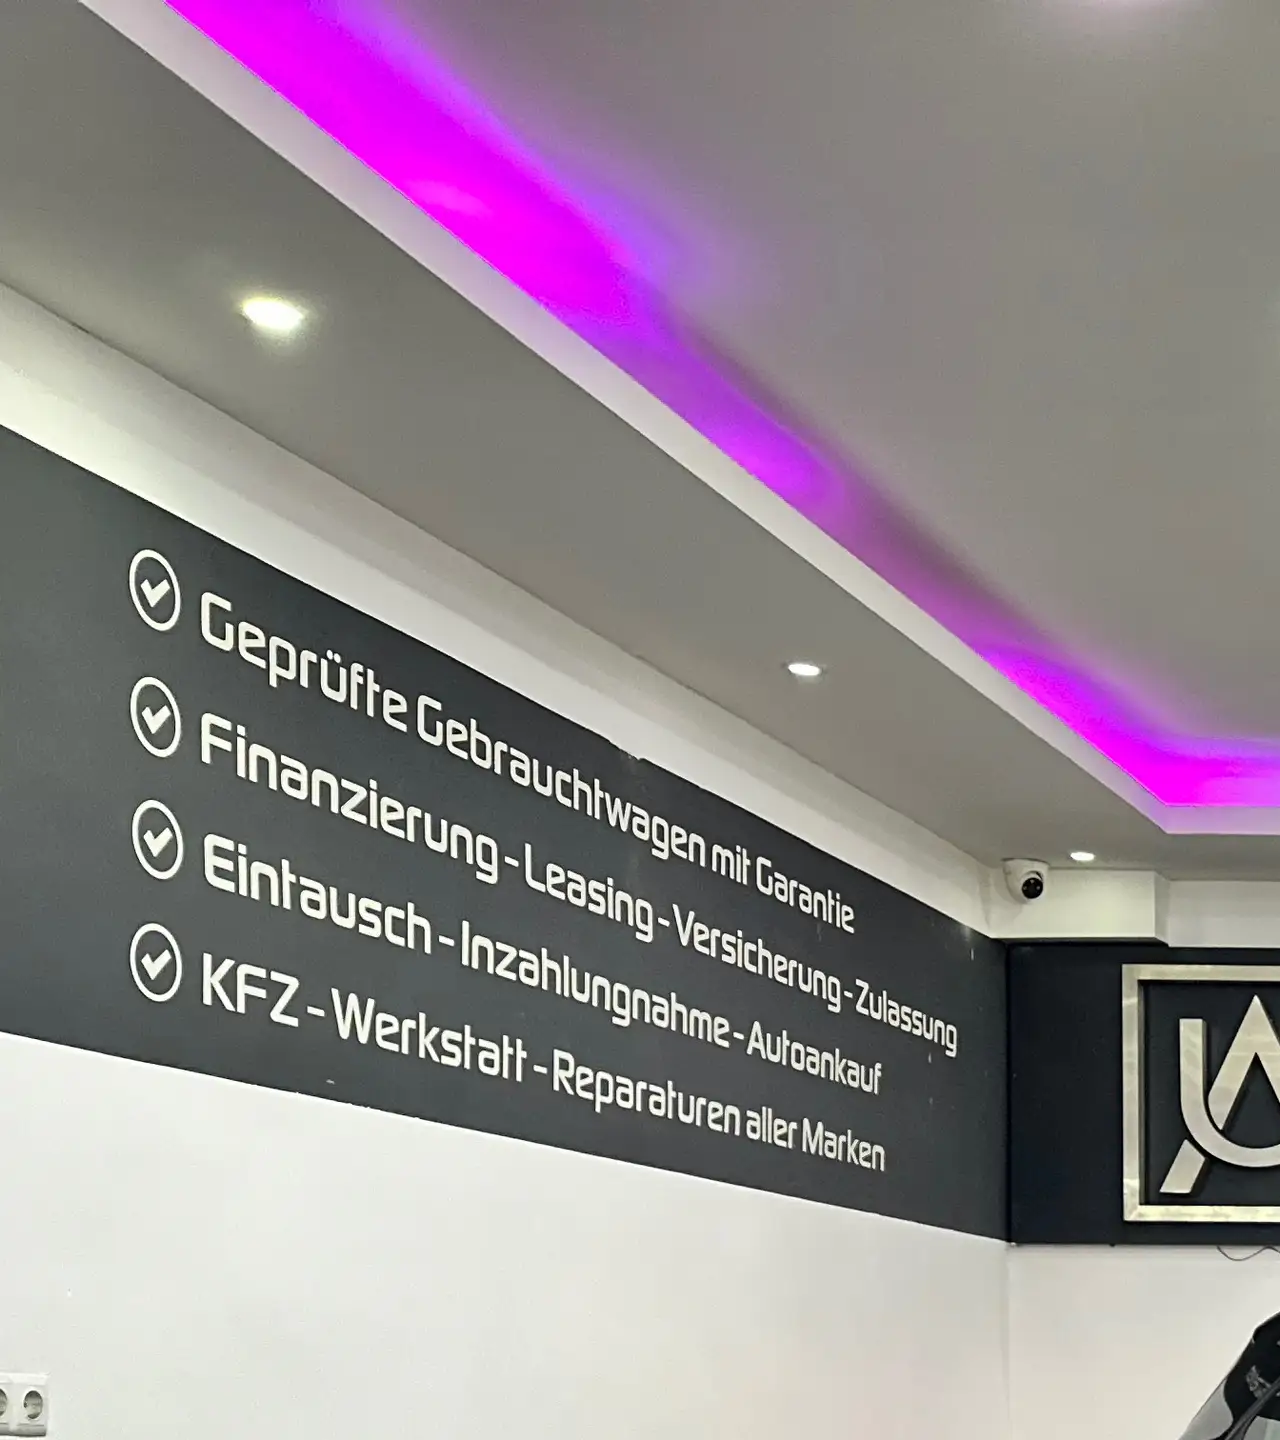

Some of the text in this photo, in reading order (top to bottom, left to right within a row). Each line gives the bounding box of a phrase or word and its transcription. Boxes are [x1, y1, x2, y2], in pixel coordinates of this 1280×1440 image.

[200, 591, 855, 934] Geprüfte Gebrauchtwagen mit Garantie
[200, 712, 499, 885] Finanzierung
[524, 842, 654, 944] Leasing
[672, 903, 841, 1014] Versicherung
[855, 978, 958, 1058] Zulassung
[202, 952, 300, 1028] KFZ
[330, 987, 528, 1083] Werkstatt
[552, 1048, 741, 1137] Reparaturen
[746, 1106, 798, 1149] aller
[802, 1117, 885, 1172] Marken
[203, 833, 432, 955] Eintausch
[461, 920, 730, 1049] Inzahlungnahme
[746, 1020, 882, 1095] Autoankauf
